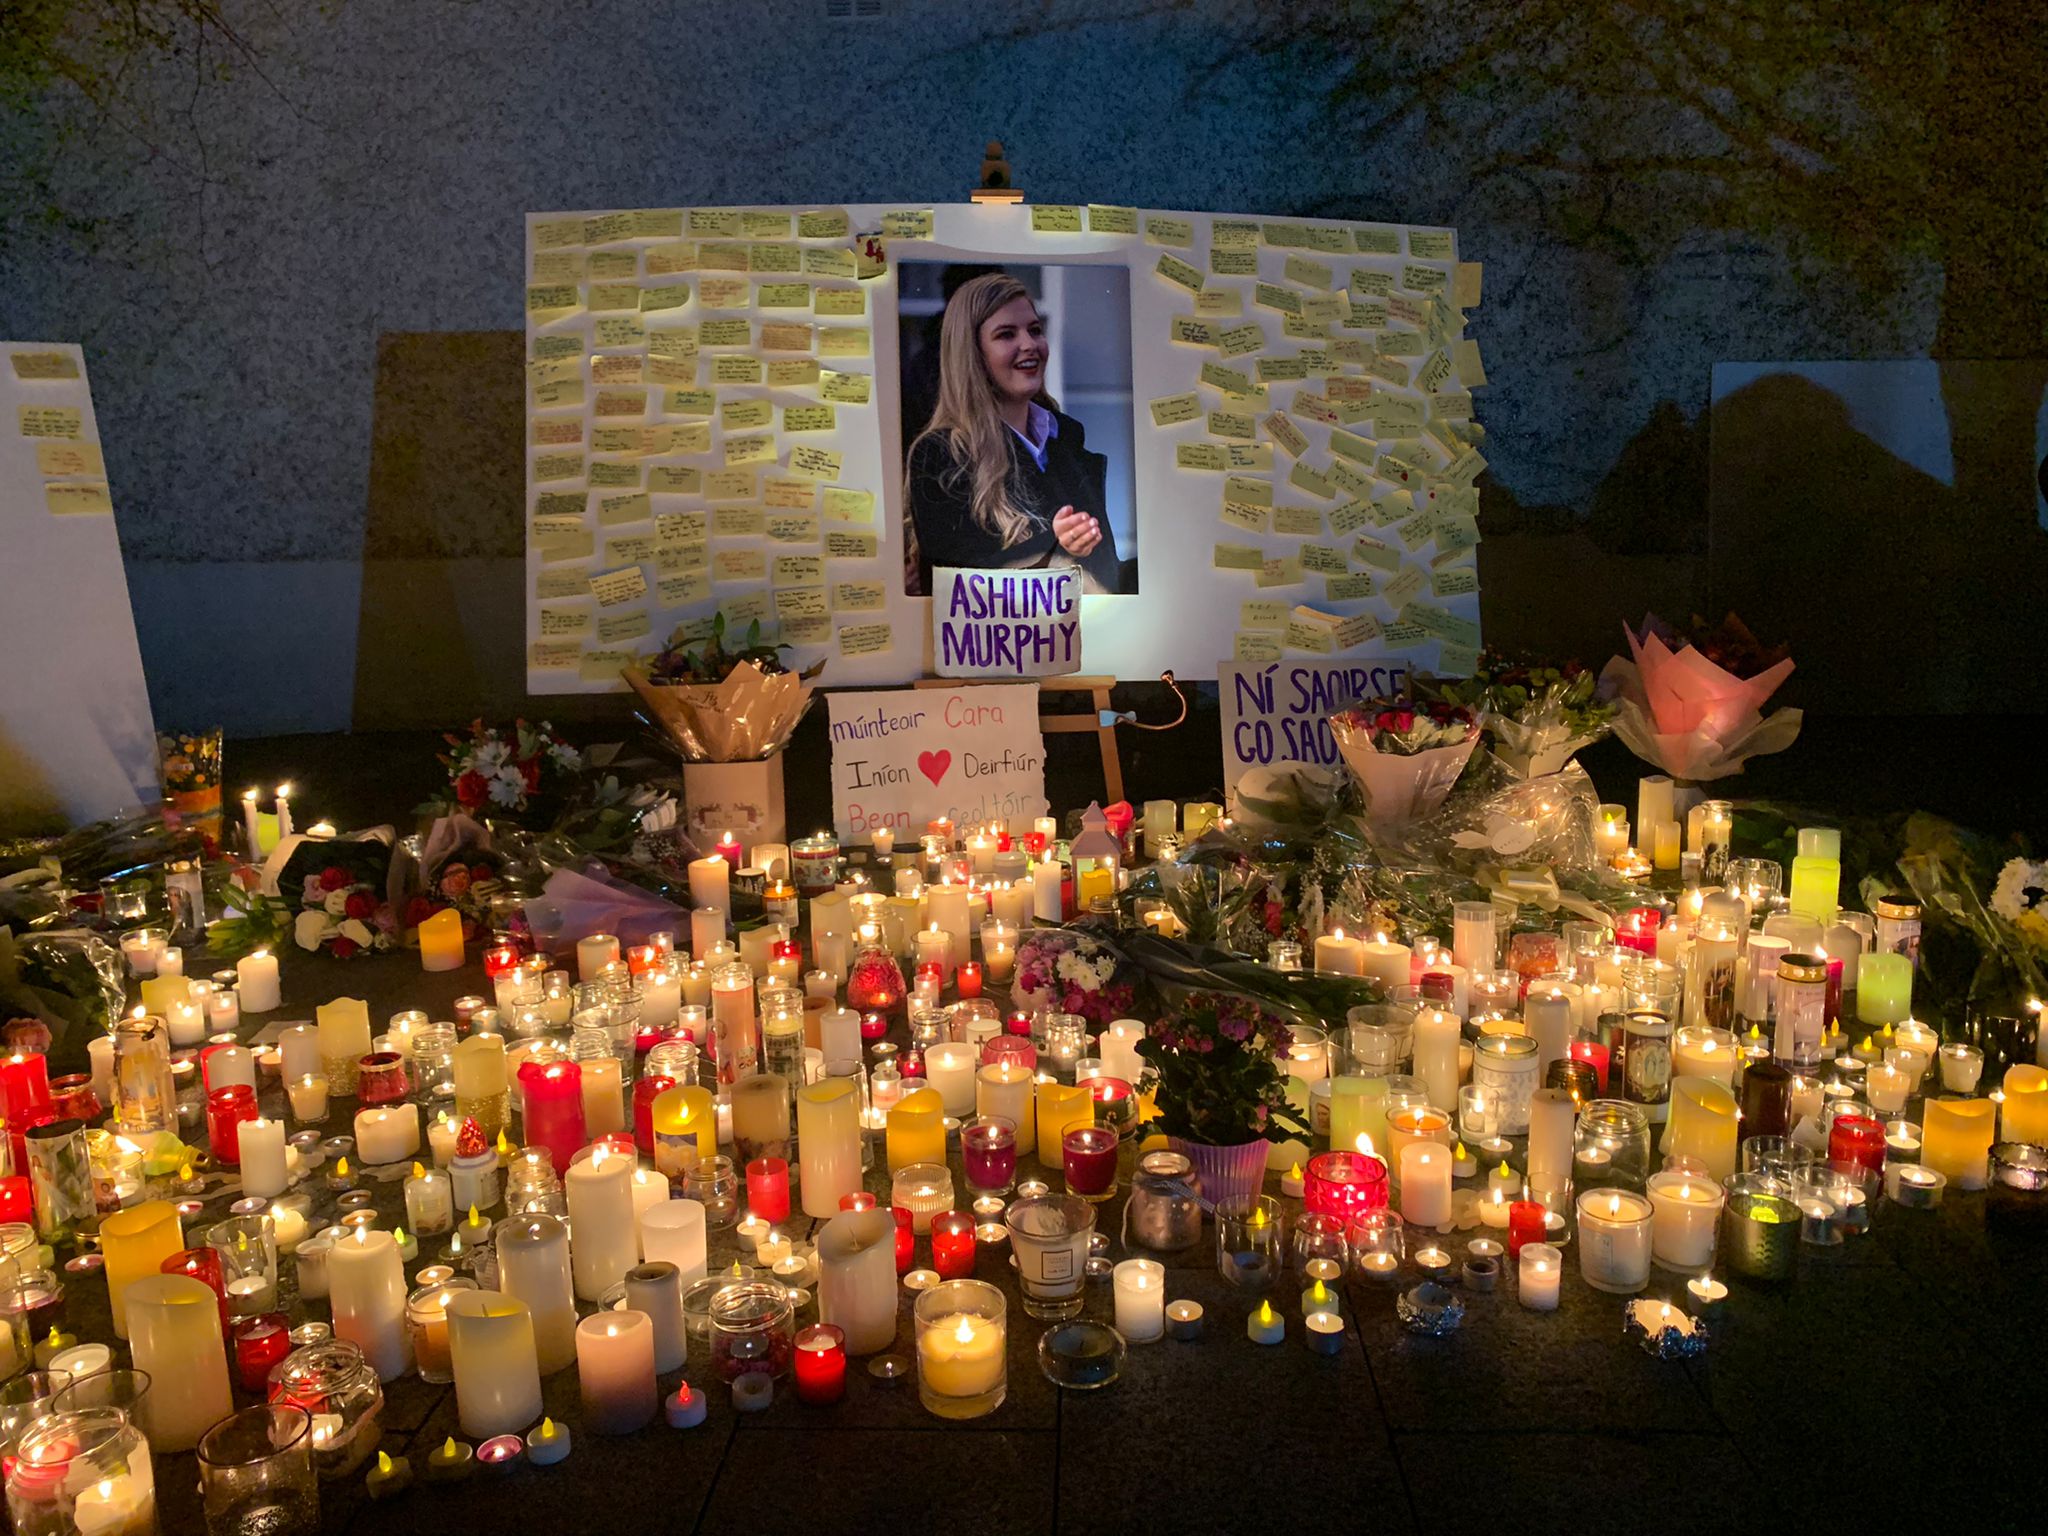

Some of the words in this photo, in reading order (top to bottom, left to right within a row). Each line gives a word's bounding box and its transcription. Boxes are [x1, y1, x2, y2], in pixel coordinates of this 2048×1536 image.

[949, 573, 1073, 620] ASHLING
[942, 621, 1077, 674] MURPHY
[944, 696, 1004, 728] Cara
[1234, 663, 1279, 716] NÍ
[1234, 719, 1274, 765] GO
[846, 760, 911, 790] Iníon
[963, 749, 1037, 778] Deirfiúr
[848, 803, 911, 833] Bean
